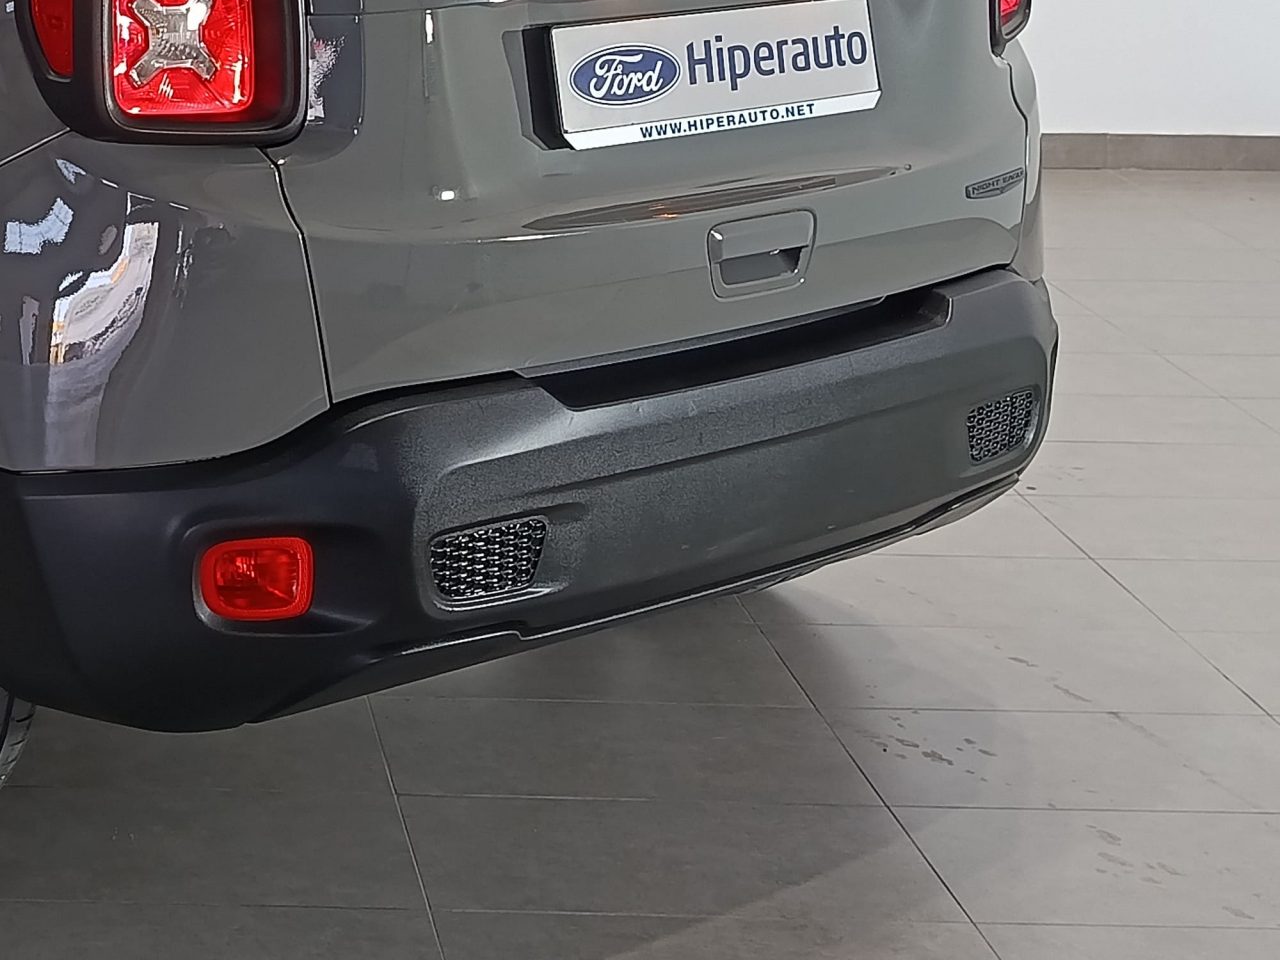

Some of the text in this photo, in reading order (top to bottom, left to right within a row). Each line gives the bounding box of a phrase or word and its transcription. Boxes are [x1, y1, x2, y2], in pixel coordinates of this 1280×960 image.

[588, 25, 868, 98] Ford Hiperauto
[639, 102, 816, 140] WWW.HIPERAUTO.NET
[971, 178, 1001, 195] NIGHT
